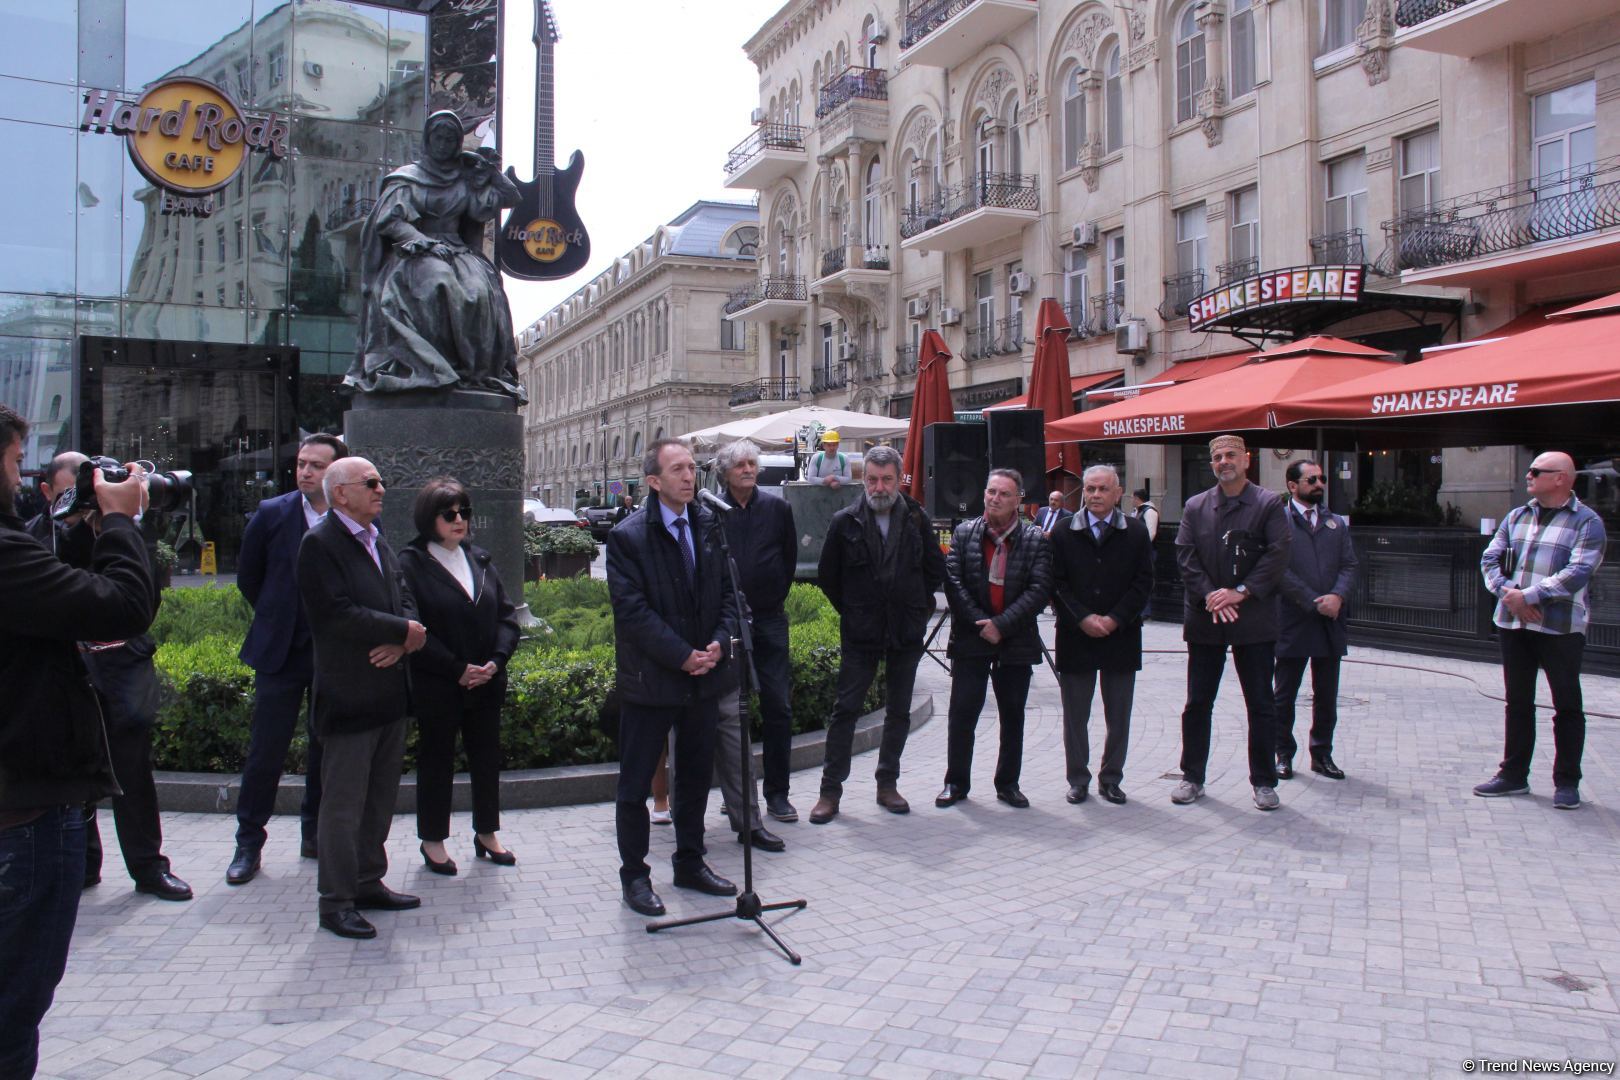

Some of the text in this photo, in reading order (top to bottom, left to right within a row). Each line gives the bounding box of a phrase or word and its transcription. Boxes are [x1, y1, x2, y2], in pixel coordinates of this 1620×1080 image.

[80, 89, 288, 158] Hard Rock
[164, 152, 215, 173] CAFE
[161, 198, 215, 218] BAKU
[507, 225, 583, 247] Hard Rock
[1189, 270, 1360, 324] SHAKESPEARE
[1371, 382, 1519, 414] SHAKESPEARE
[1103, 414, 1186, 436] SHAKESPEARE
